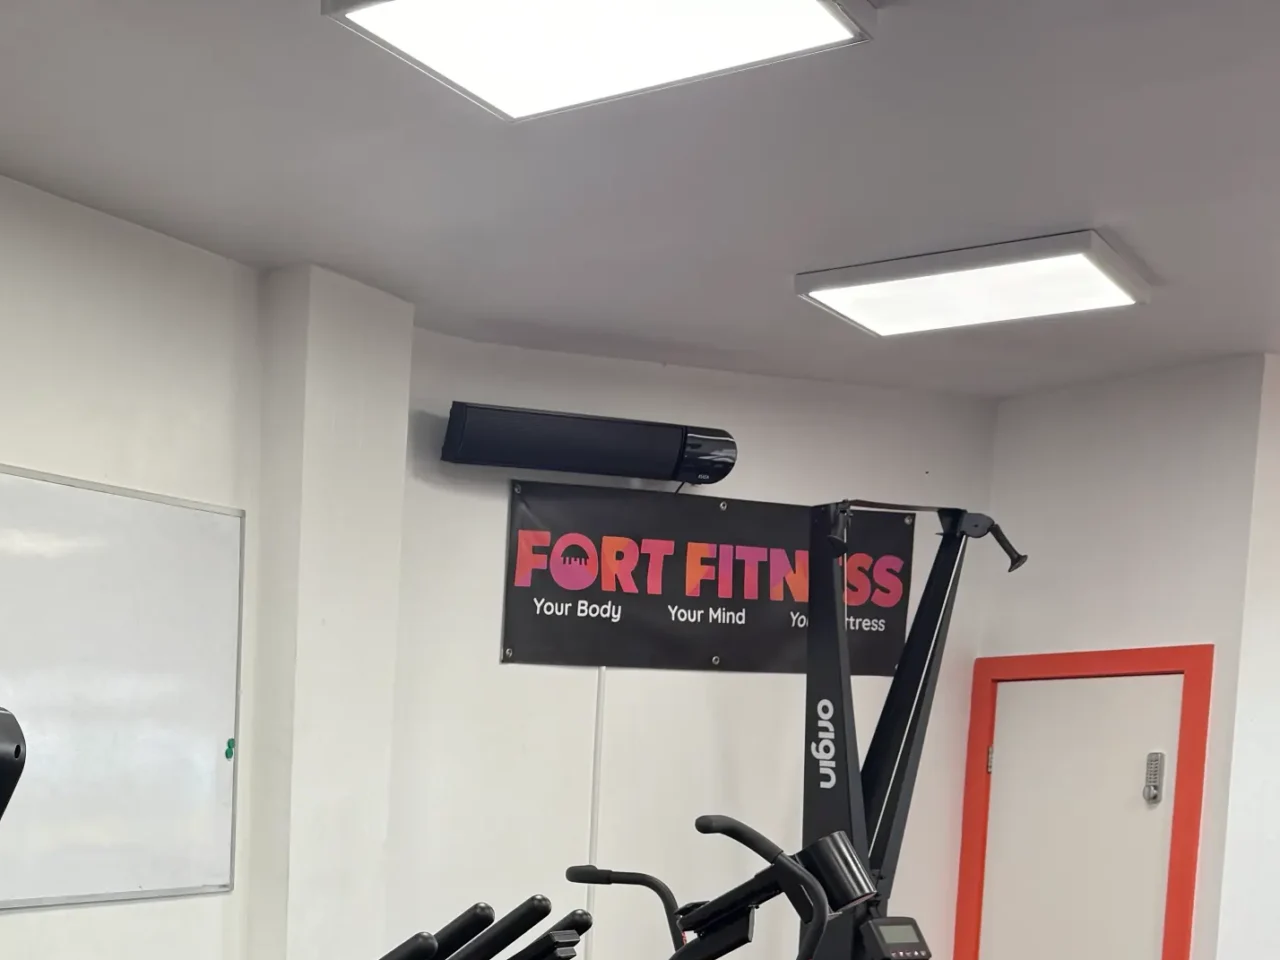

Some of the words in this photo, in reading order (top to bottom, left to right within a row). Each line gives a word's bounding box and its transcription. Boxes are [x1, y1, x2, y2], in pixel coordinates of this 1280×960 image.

[514, 529, 675, 595] FORT
[684, 541, 904, 608] FITNSS
[533, 598, 572, 616] Your
[577, 600, 622, 623] Body
[668, 605, 704, 623] Your
[708, 607, 746, 625] Mind
[790, 611, 809, 628] Yo
[845, 616, 886, 632] rtress
[810, 698, 837, 789] origin
